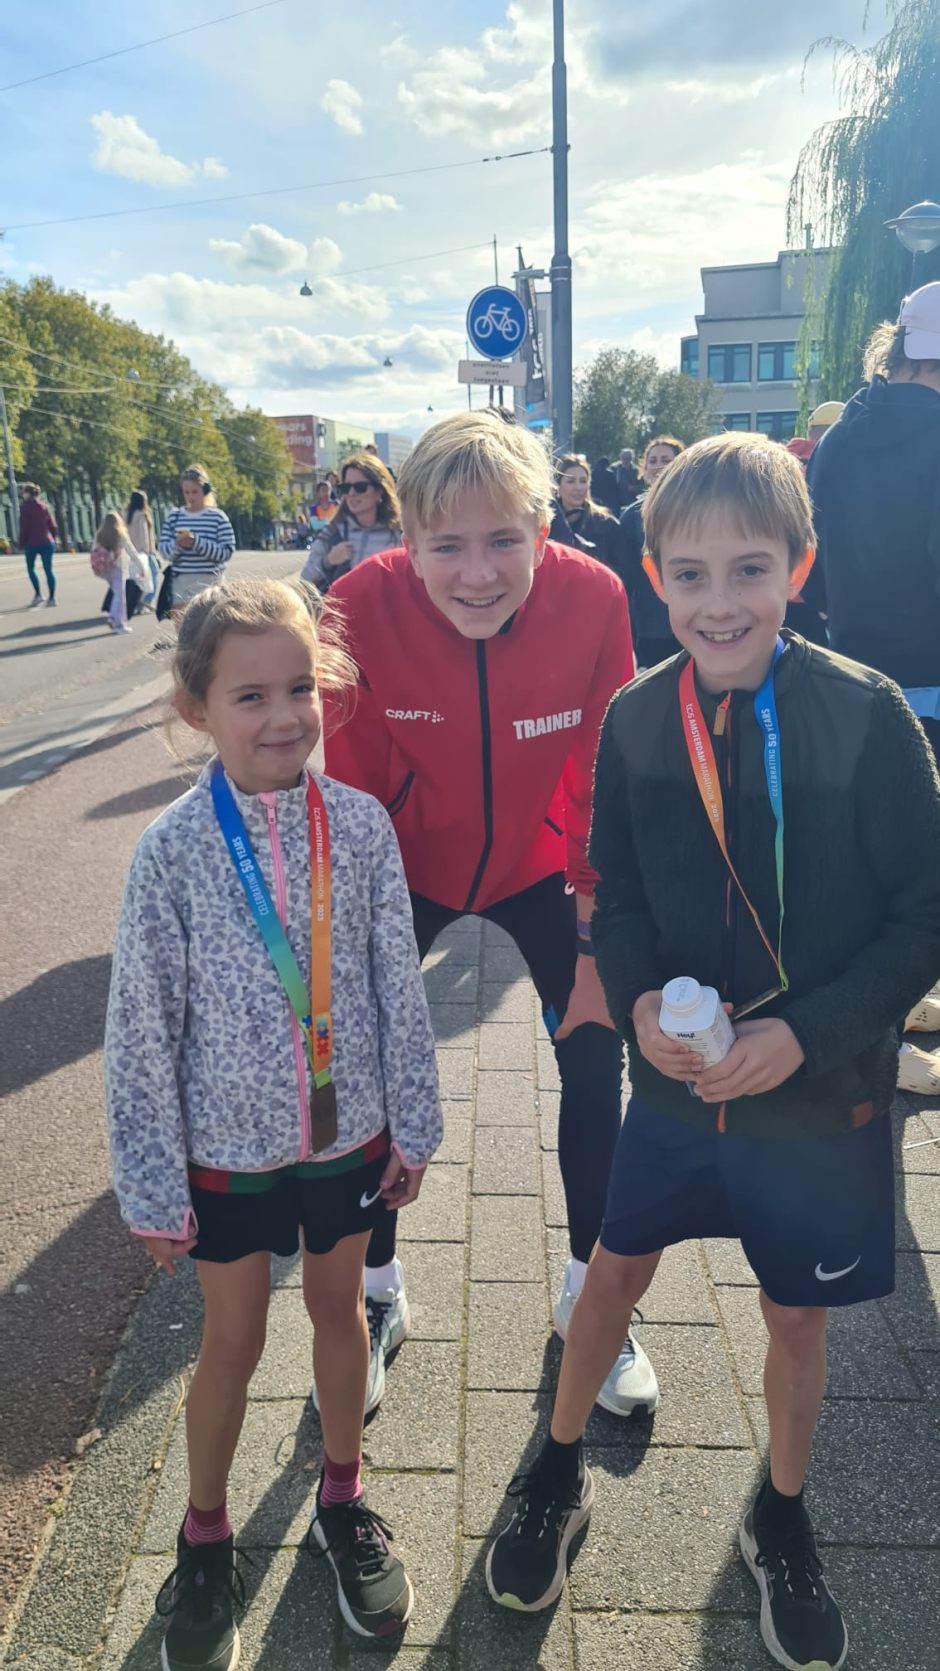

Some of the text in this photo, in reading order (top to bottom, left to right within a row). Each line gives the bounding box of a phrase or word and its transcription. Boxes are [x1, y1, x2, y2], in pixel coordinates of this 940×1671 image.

[385, 709, 431, 720] CRAFT
[513, 709, 582, 739] TRAINER
[689, 719, 705, 762] AMSTERDAM
[700, 762, 713, 800] MARATHON
[711, 804, 719, 822] 2025
[762, 708, 777, 796] CELEBRATING 50 YEARS
[315, 820, 324, 863] AMSTERDAM
[232, 836, 269, 916] CELEBRATING 50 YEARS
